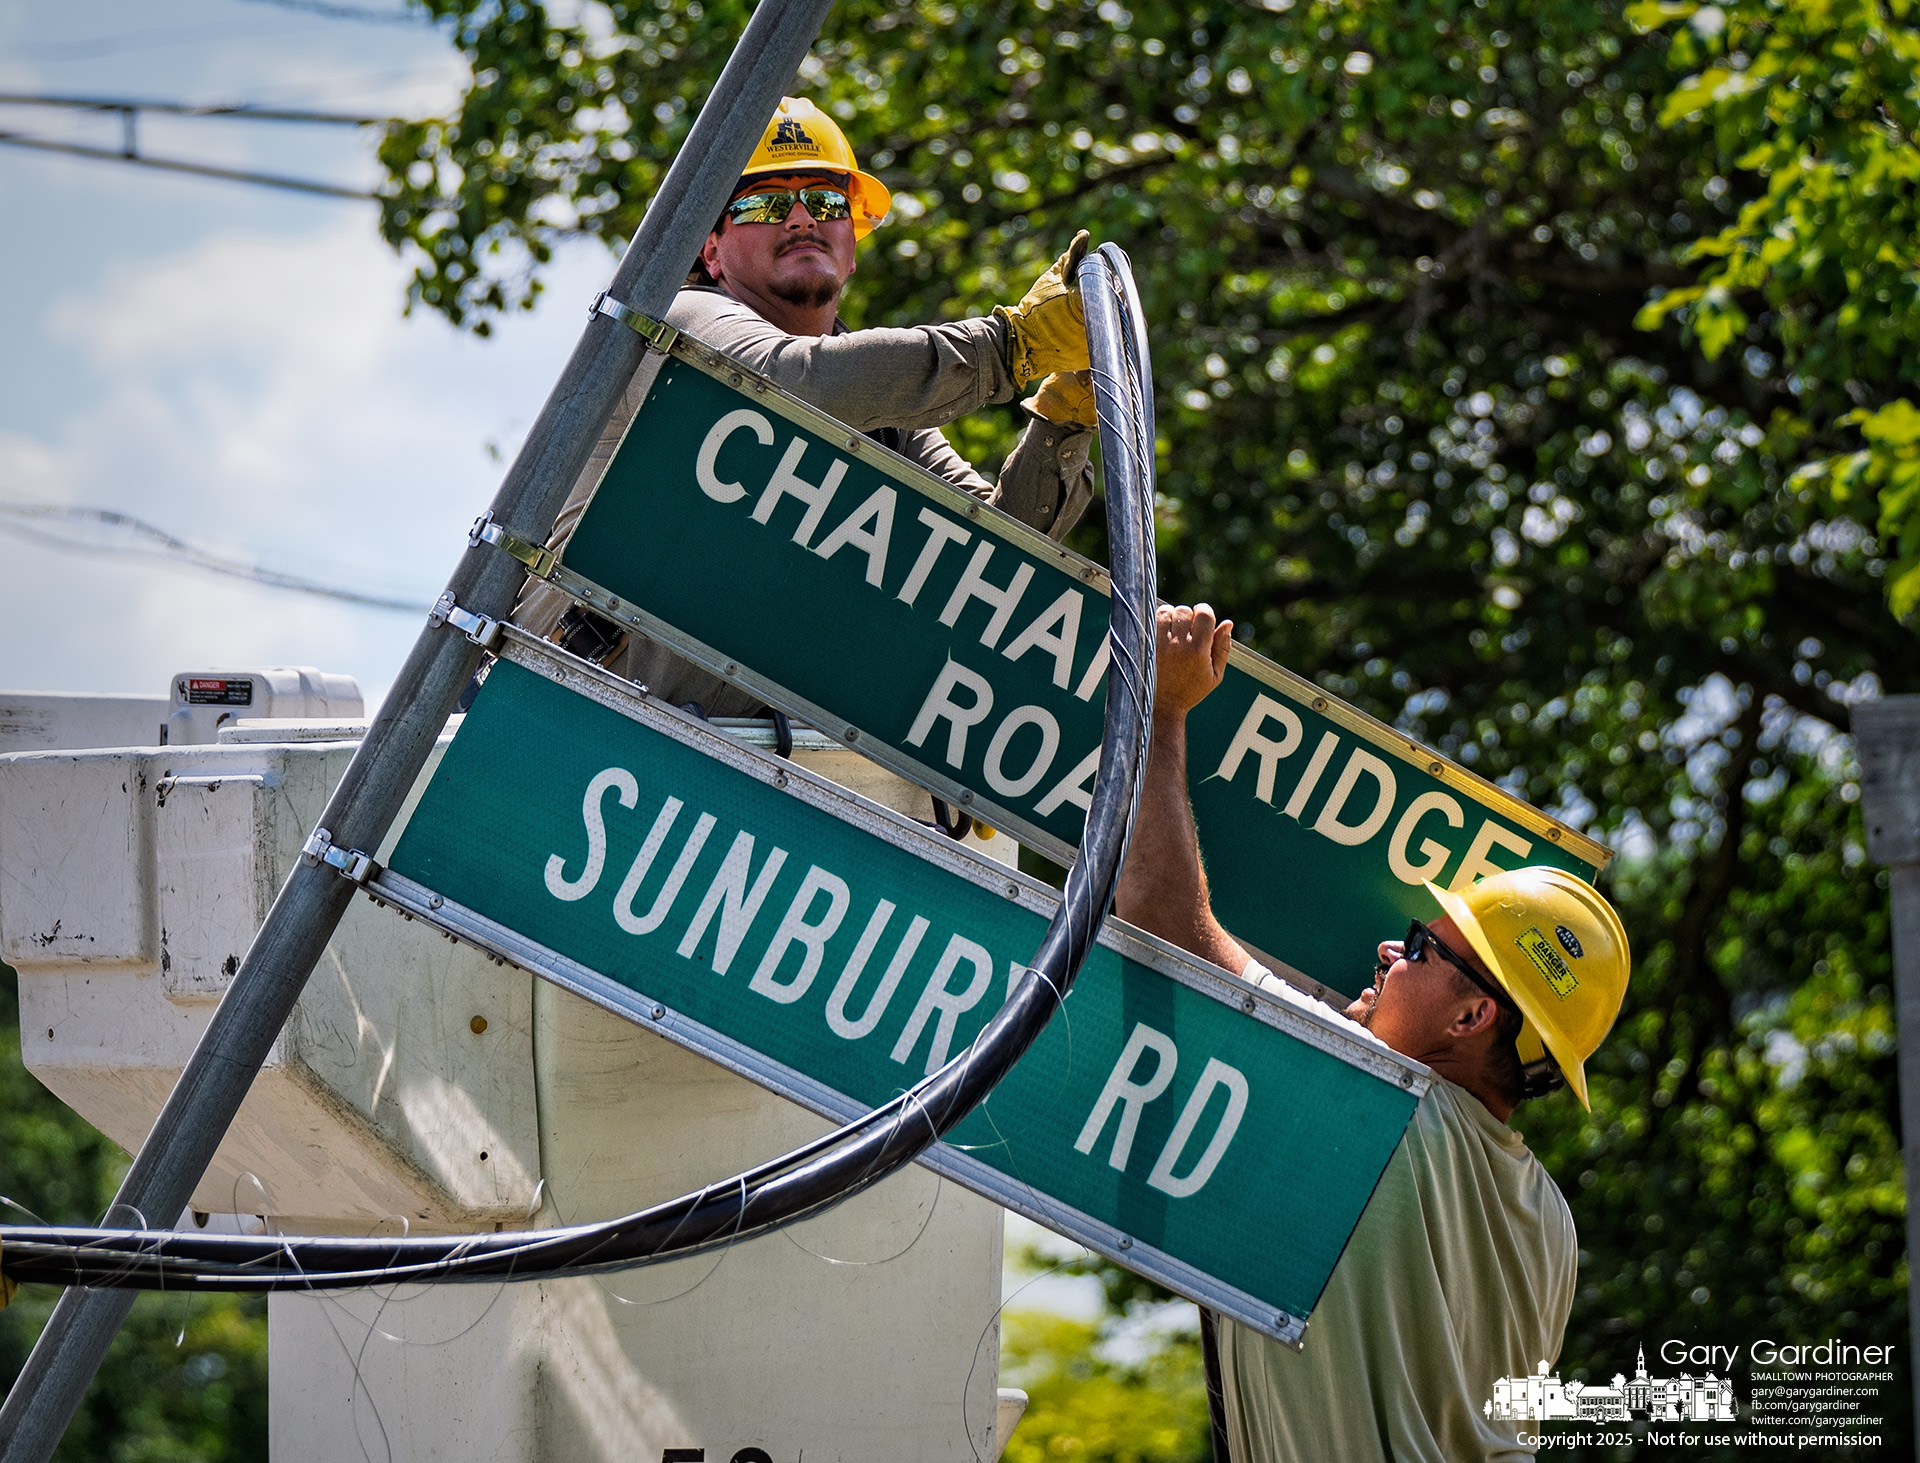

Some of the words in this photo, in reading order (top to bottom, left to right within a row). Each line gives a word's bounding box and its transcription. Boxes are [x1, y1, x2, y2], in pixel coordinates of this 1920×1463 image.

[766, 143, 821, 153] WESTERVILLE
[695, 408, 1111, 703] CHATHA
[199, 681, 220, 689] DANGER
[904, 657, 1103, 817] ROA
[543, 766, 1073, 1105] SUNBUR
[1073, 1022, 1250, 1199] RD
[1536, 940, 1567, 978] DANGER
